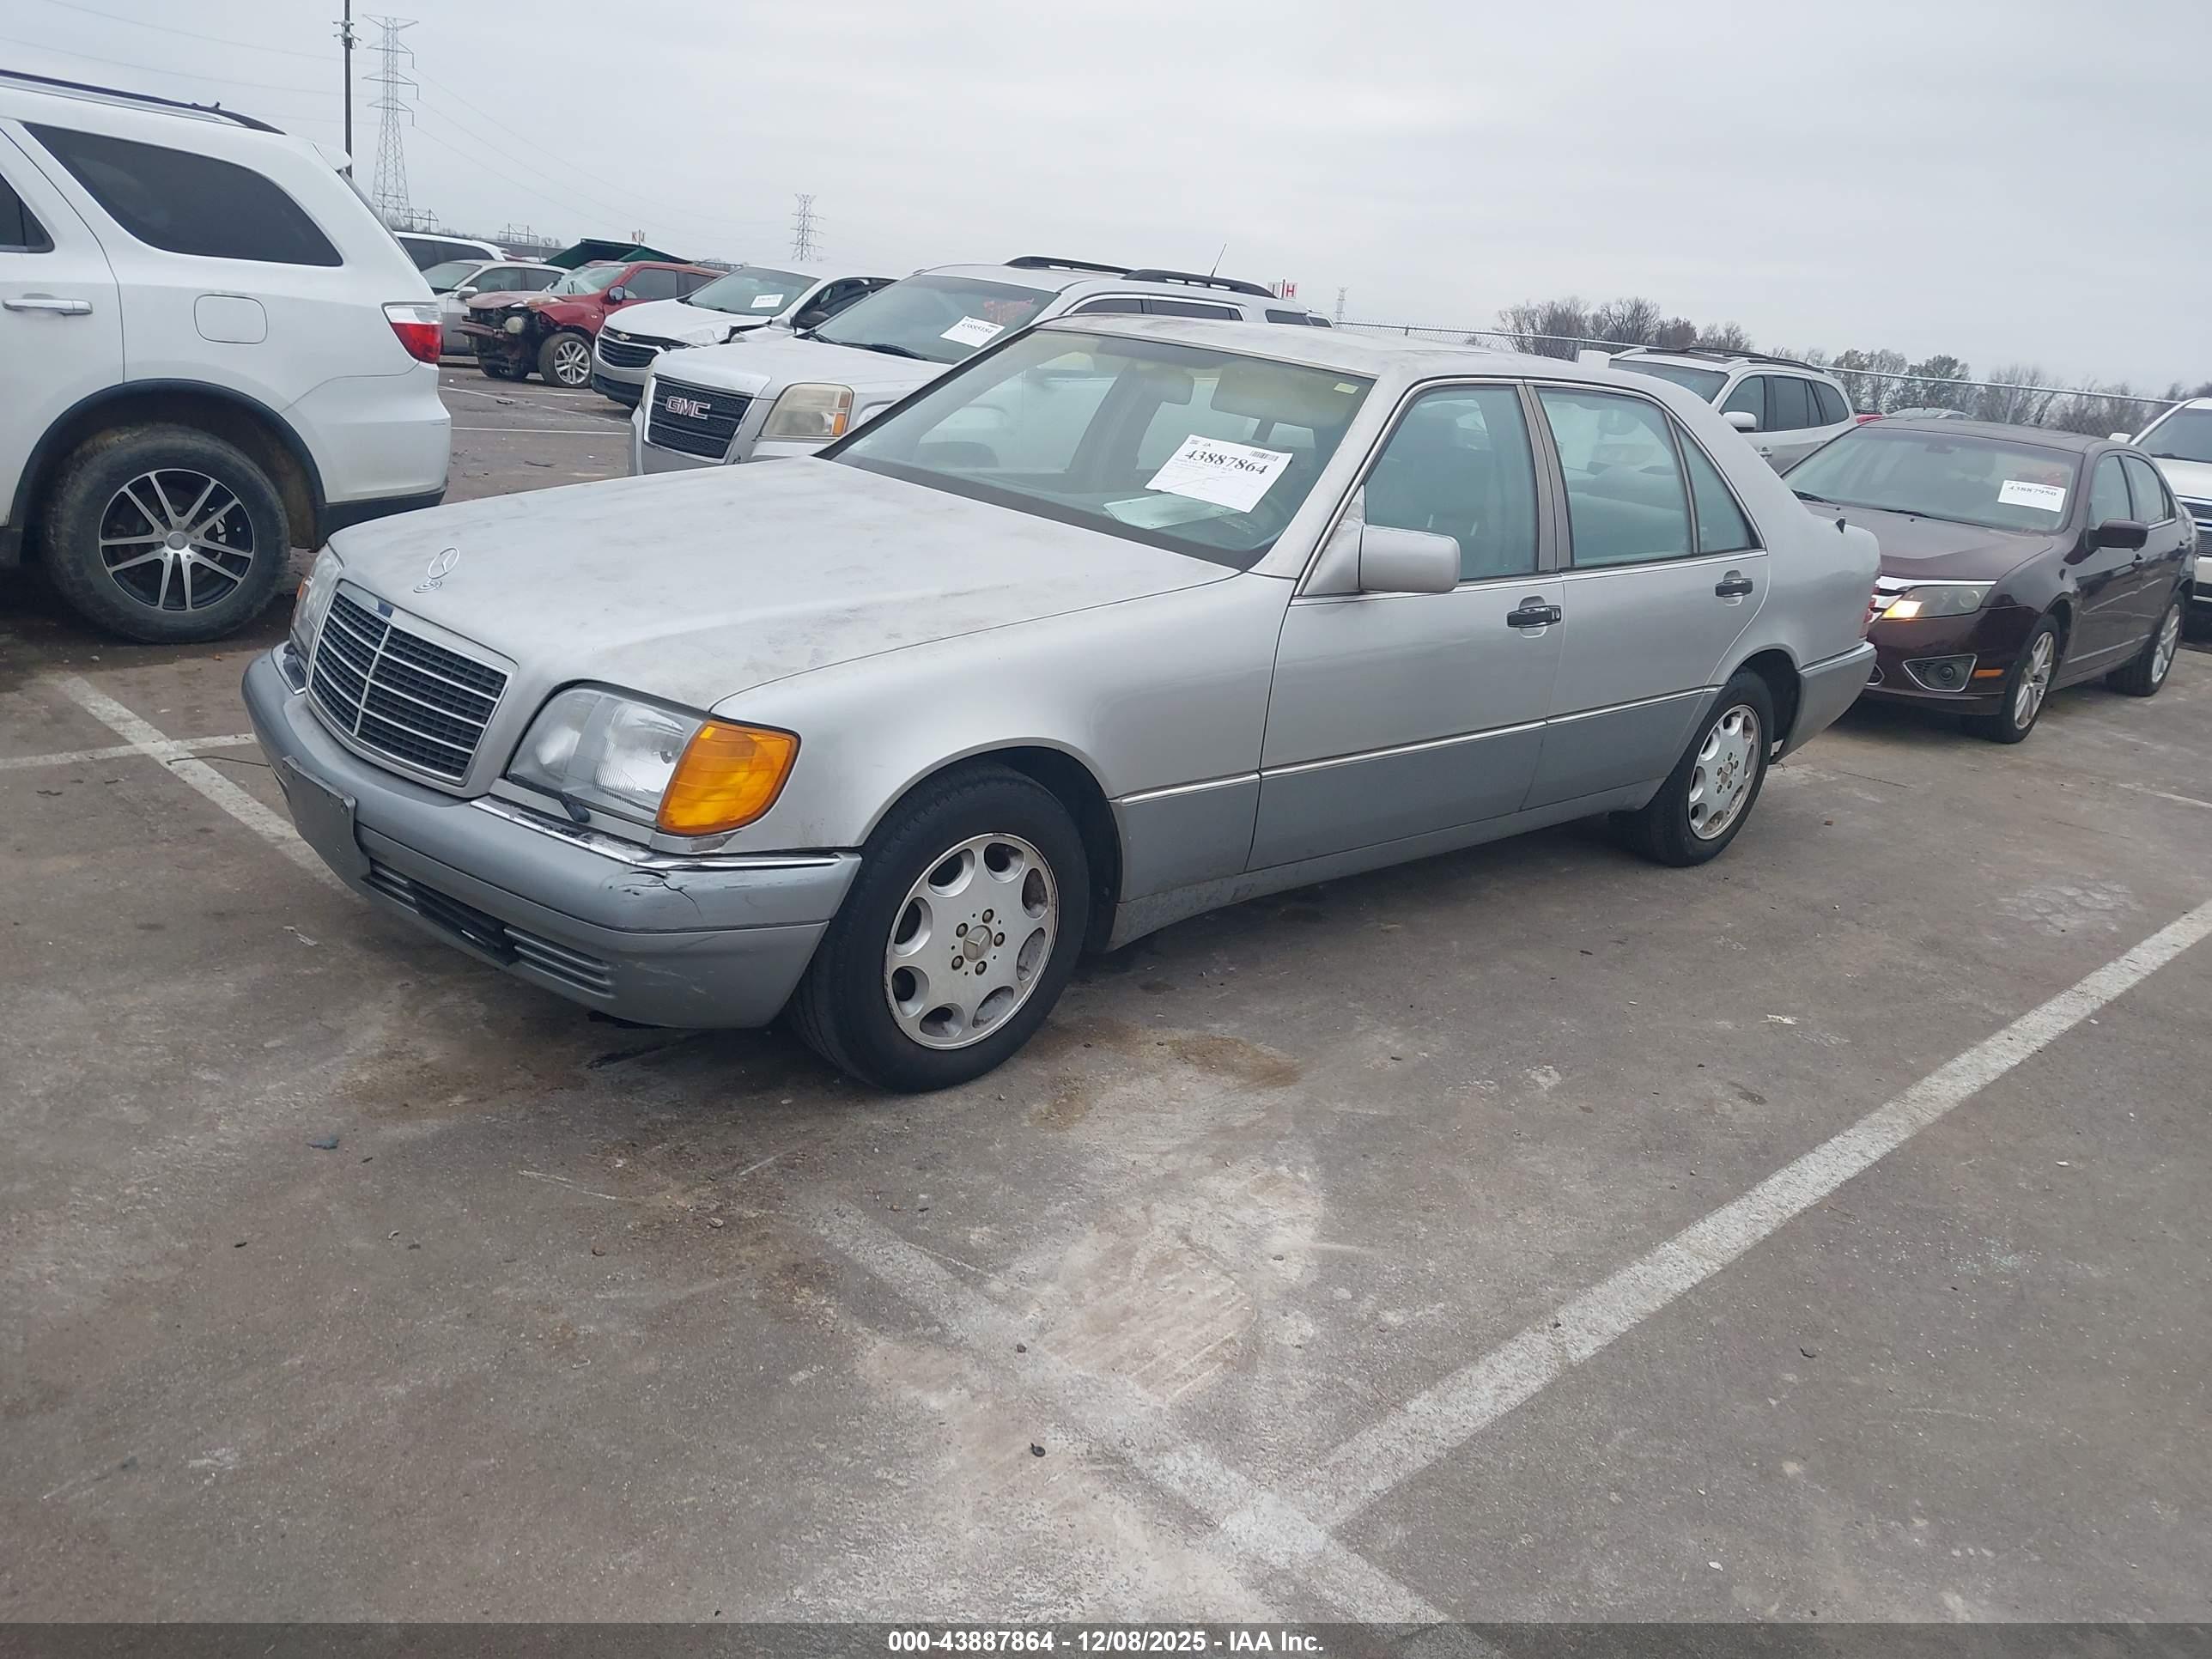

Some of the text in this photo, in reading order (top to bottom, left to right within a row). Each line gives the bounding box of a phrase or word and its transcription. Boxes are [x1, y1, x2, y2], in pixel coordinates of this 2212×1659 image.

[1285, 284, 1295, 297] H
[665, 396, 712, 420] GMC
[1184, 449, 1269, 475] 43887864
